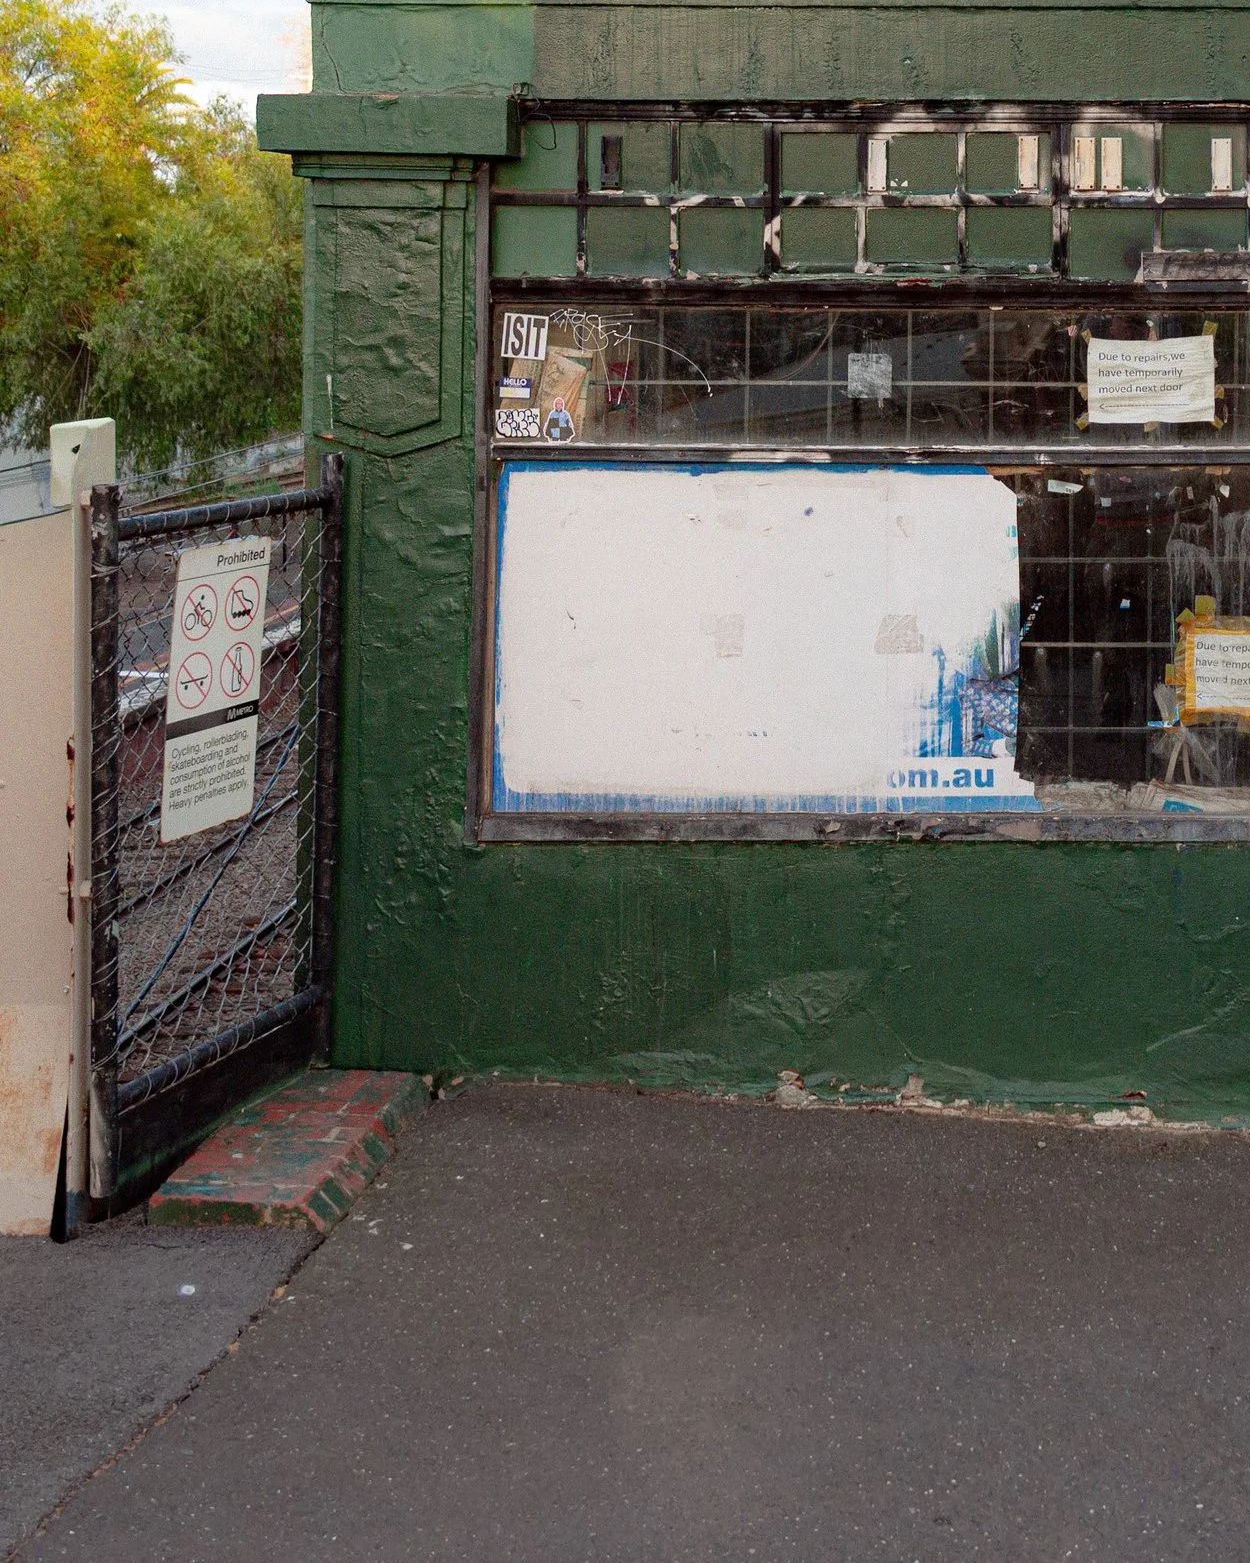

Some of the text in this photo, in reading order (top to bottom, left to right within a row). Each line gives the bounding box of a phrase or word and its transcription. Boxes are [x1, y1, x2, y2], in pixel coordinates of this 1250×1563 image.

[503, 315, 546, 358] ISIT
[1098, 352, 1119, 361] Due
[1121, 352, 1132, 362] to
[1098, 367, 1183, 378] have temporarily
[503, 377, 528, 386] HELLO
[1098, 383, 1183, 394] moved next door
[217, 547, 266, 567] Prohibited
[1196, 641, 1216, 651] Due
[1195, 657, 1219, 667] have
[170, 744, 239, 772] skateboarding and
[169, 751, 251, 786] consumption of alcohol
[168, 788, 182, 799] are
[183, 778, 208, 793] strictly
[168, 797, 192, 811] Heavy
[193, 785, 227, 806] penalties
